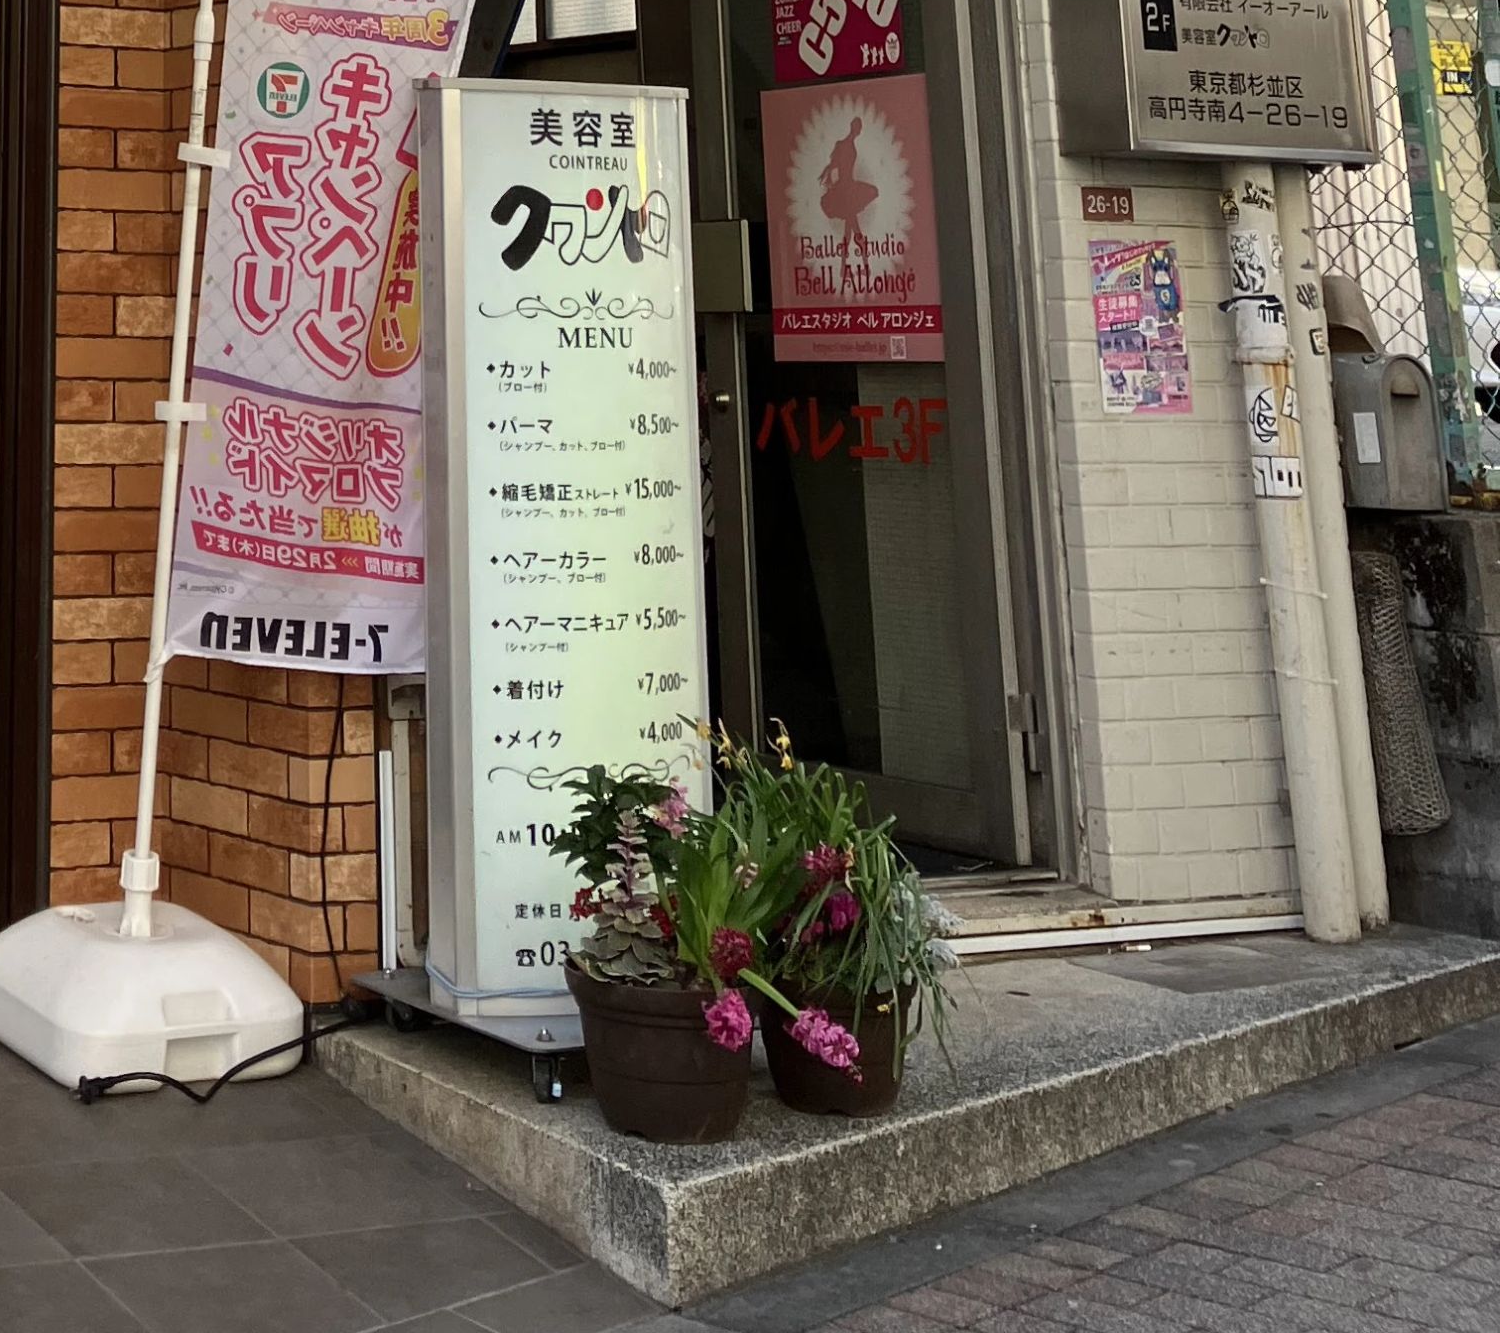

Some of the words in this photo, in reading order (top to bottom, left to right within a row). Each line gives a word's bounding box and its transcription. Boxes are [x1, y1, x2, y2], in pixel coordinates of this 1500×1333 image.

[775, 4, 796, 19] JAZZ
[1145, 1, 1171, 33] 2F
[776, 20, 802, 36] CHEER
[1188, 69, 1305, 100] 東京都杉並区
[529, 107, 637, 150] 美容室
[549, 153, 629, 172] COINTREAU
[1087, 194, 1130, 216] 26-19
[800, 235, 850, 261] Ballet
[853, 233, 905, 259] Studio
[793, 264, 837, 297] Bell
[781, 311, 852, 330] バレエスタジオ
[881, 309, 936, 329] アロンジェ
[557, 326, 634, 350] MENU
[499, 359, 552, 381] カット
[499, 416, 554, 435] パーマ
[503, 550, 608, 569] ヘアーカラー
[505, 611, 630, 634] ヘアーマニキュア
[506, 678, 565, 701] 着付け
[506, 728, 563, 749] メイク
[495, 829, 520, 844] AM
